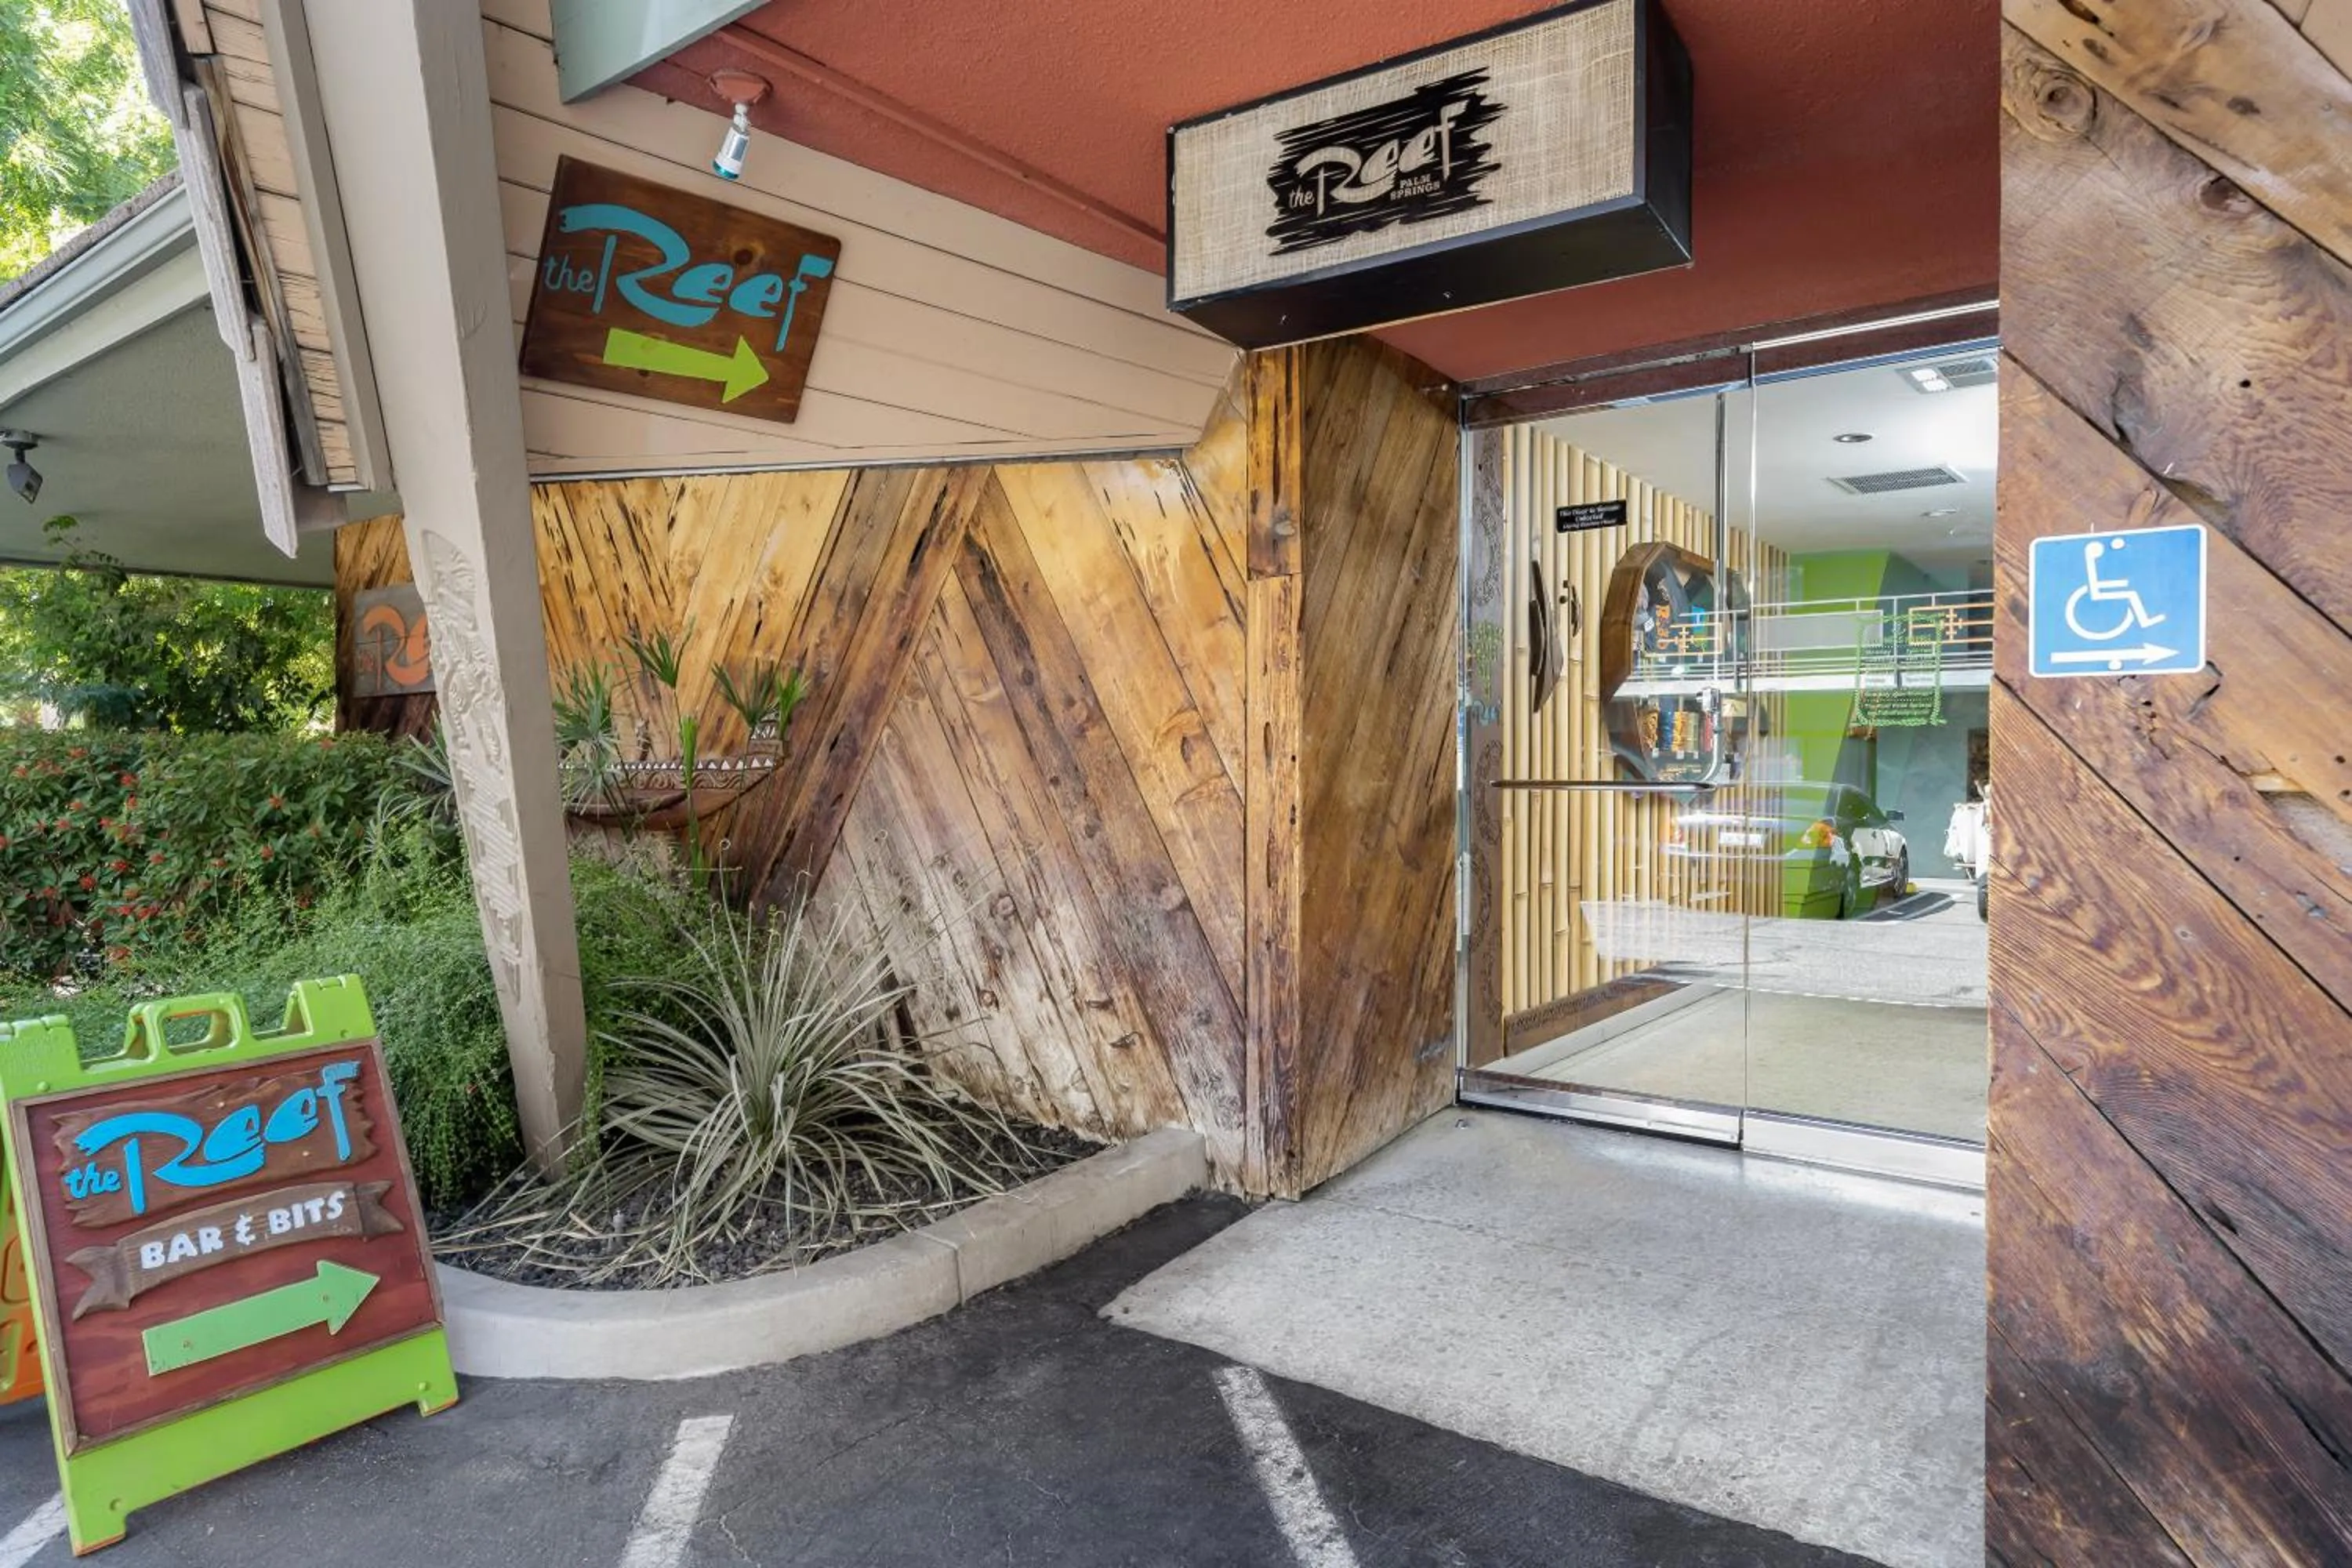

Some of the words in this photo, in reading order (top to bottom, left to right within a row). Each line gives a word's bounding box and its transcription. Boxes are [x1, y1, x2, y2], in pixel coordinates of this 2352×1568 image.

[1294, 99, 1470, 219] Reef
[1290, 185, 1316, 208] the
[1390, 180, 1440, 201] SPRINGS
[1399, 173, 1431, 189] PALM
[543, 254, 596, 293] the
[559, 203, 834, 352] Reef
[74, 1060, 361, 1215] Reef
[62, 1162, 122, 1200] the
[139, 1225, 224, 1270] BAR
[234, 1213, 256, 1246] &
[267, 1190, 346, 1235] BITS
